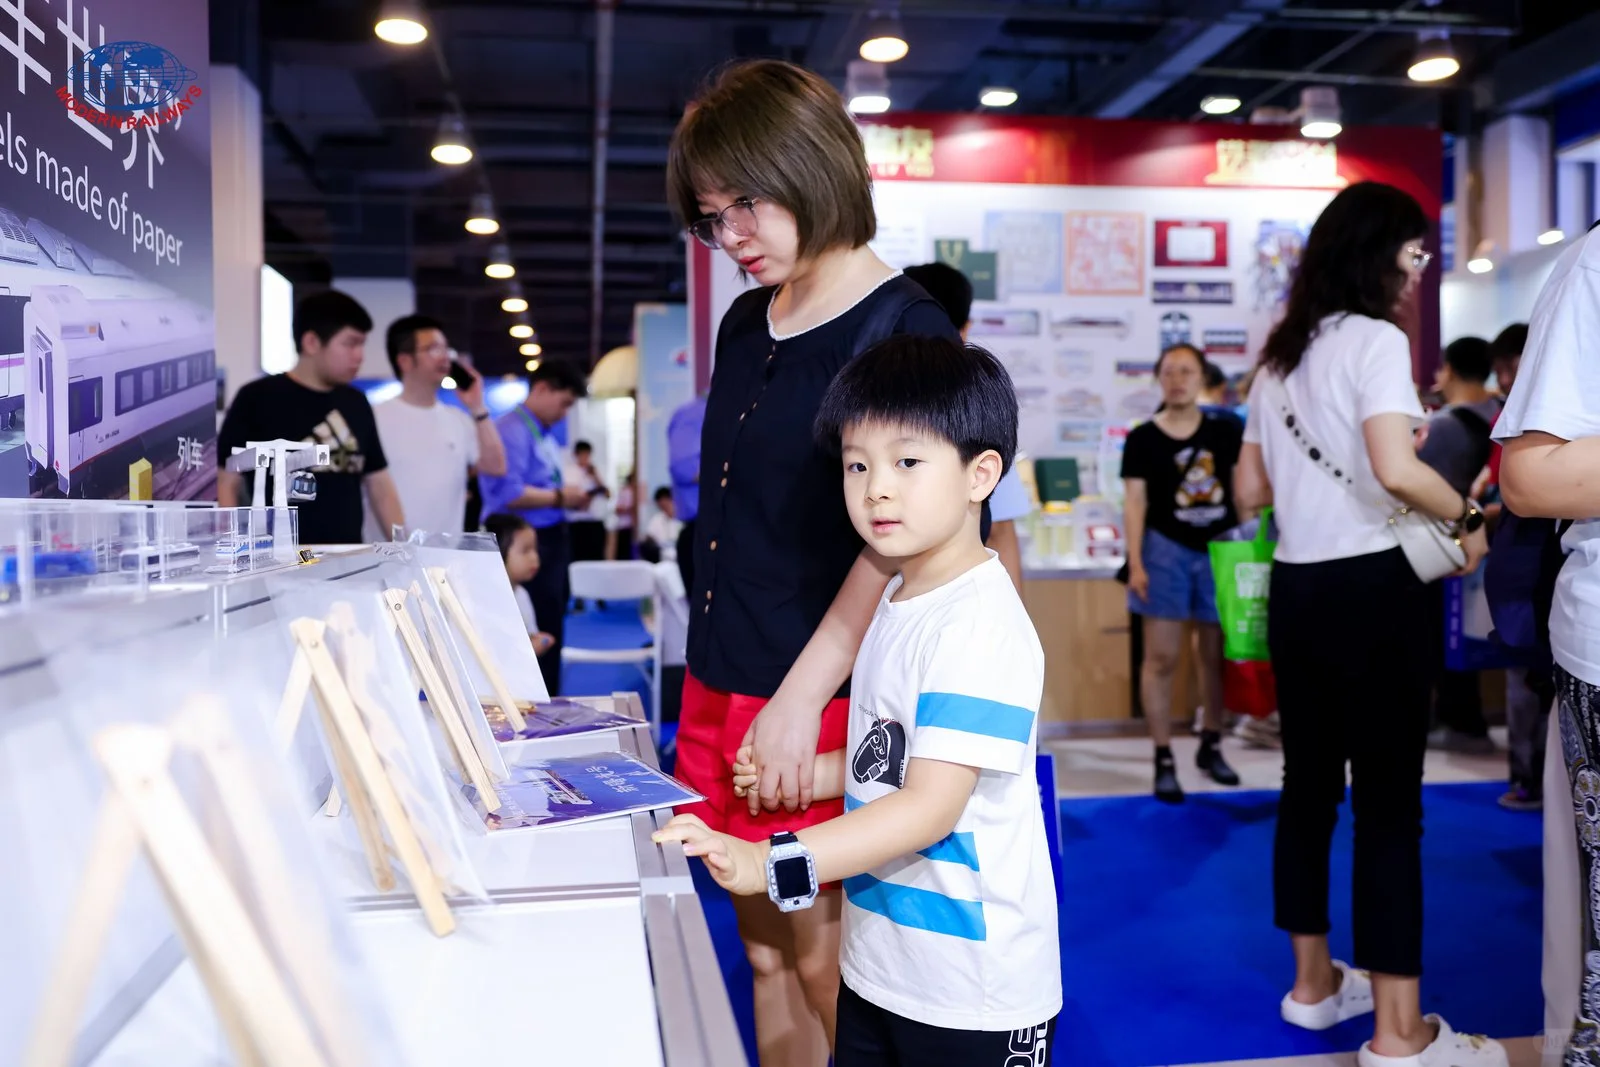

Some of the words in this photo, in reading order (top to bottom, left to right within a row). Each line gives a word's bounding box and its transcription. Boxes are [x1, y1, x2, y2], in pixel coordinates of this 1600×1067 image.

[36, 148, 103, 220] made
[108, 192, 128, 235] of
[133, 211, 183, 266] paper
[177, 436, 203, 471] 列车
